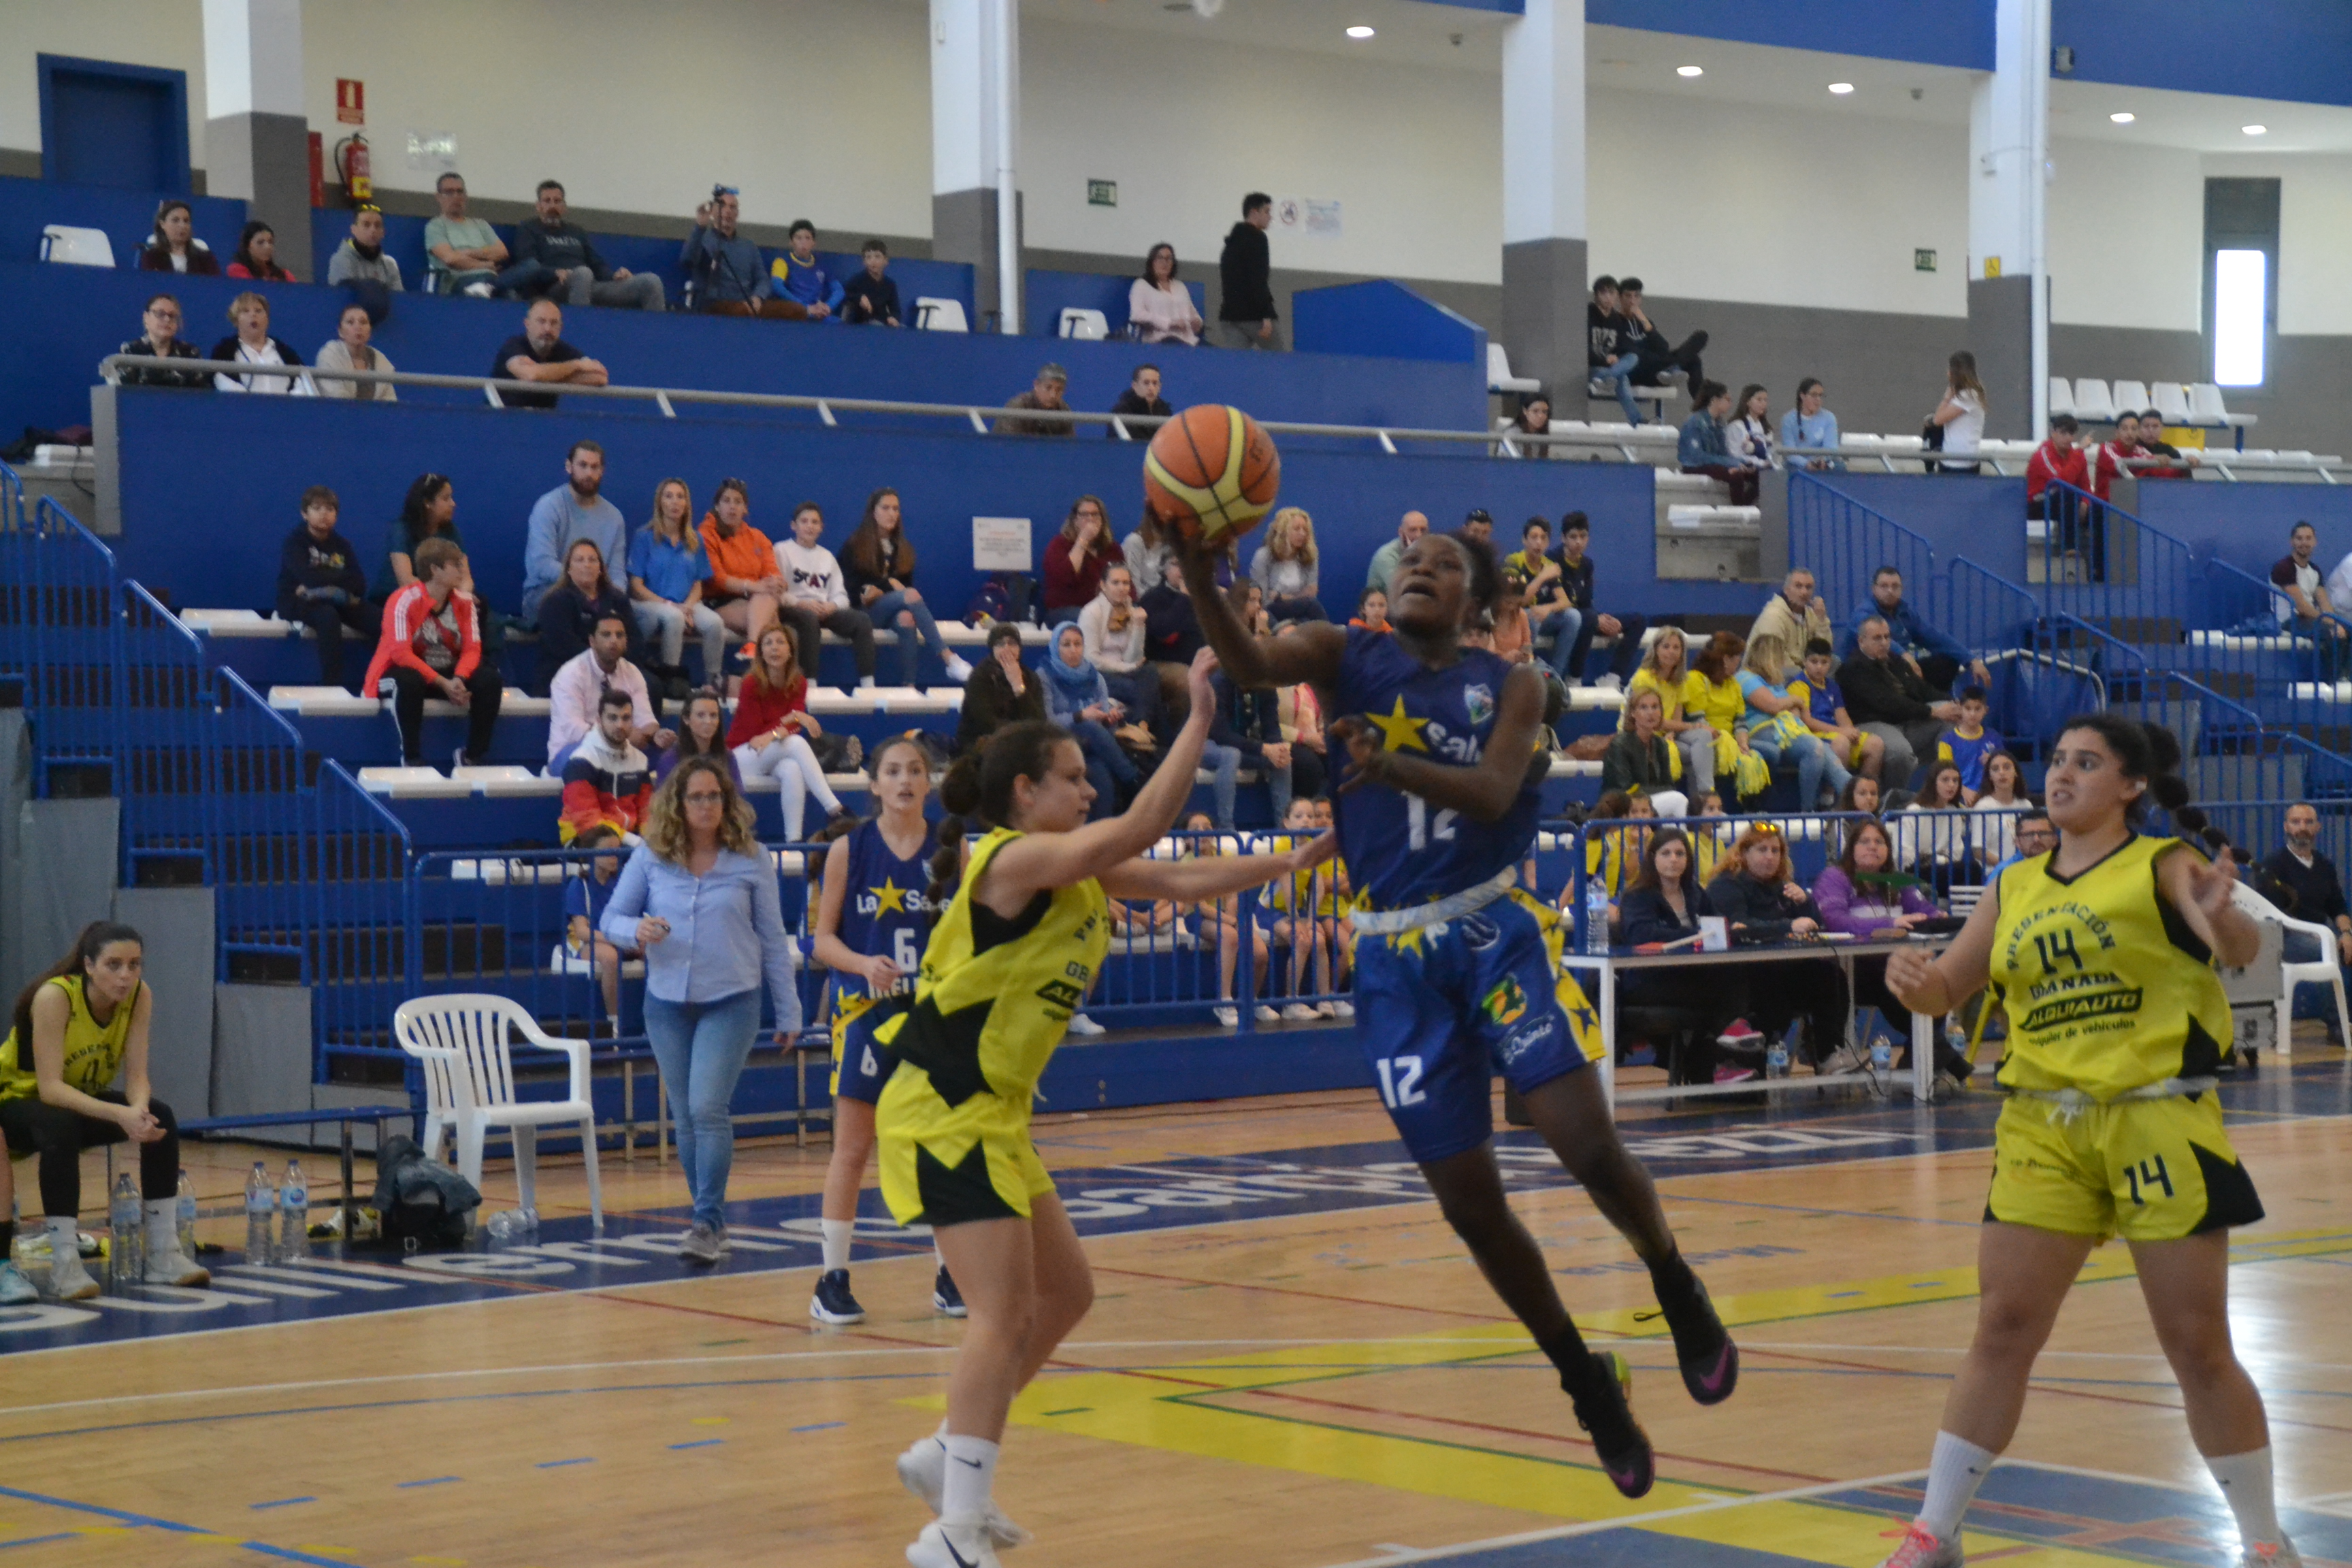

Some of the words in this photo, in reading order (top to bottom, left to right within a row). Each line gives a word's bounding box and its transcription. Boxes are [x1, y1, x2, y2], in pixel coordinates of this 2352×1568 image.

[856, 894, 878, 914] La
[906, 889, 953, 913] Sae
[894, 927, 917, 974] 6
[2034, 927, 2083, 975] 14
[860, 1044, 878, 1077] 6
[1377, 1054, 1426, 1109] 12
[2123, 1154, 2174, 1205] 14
